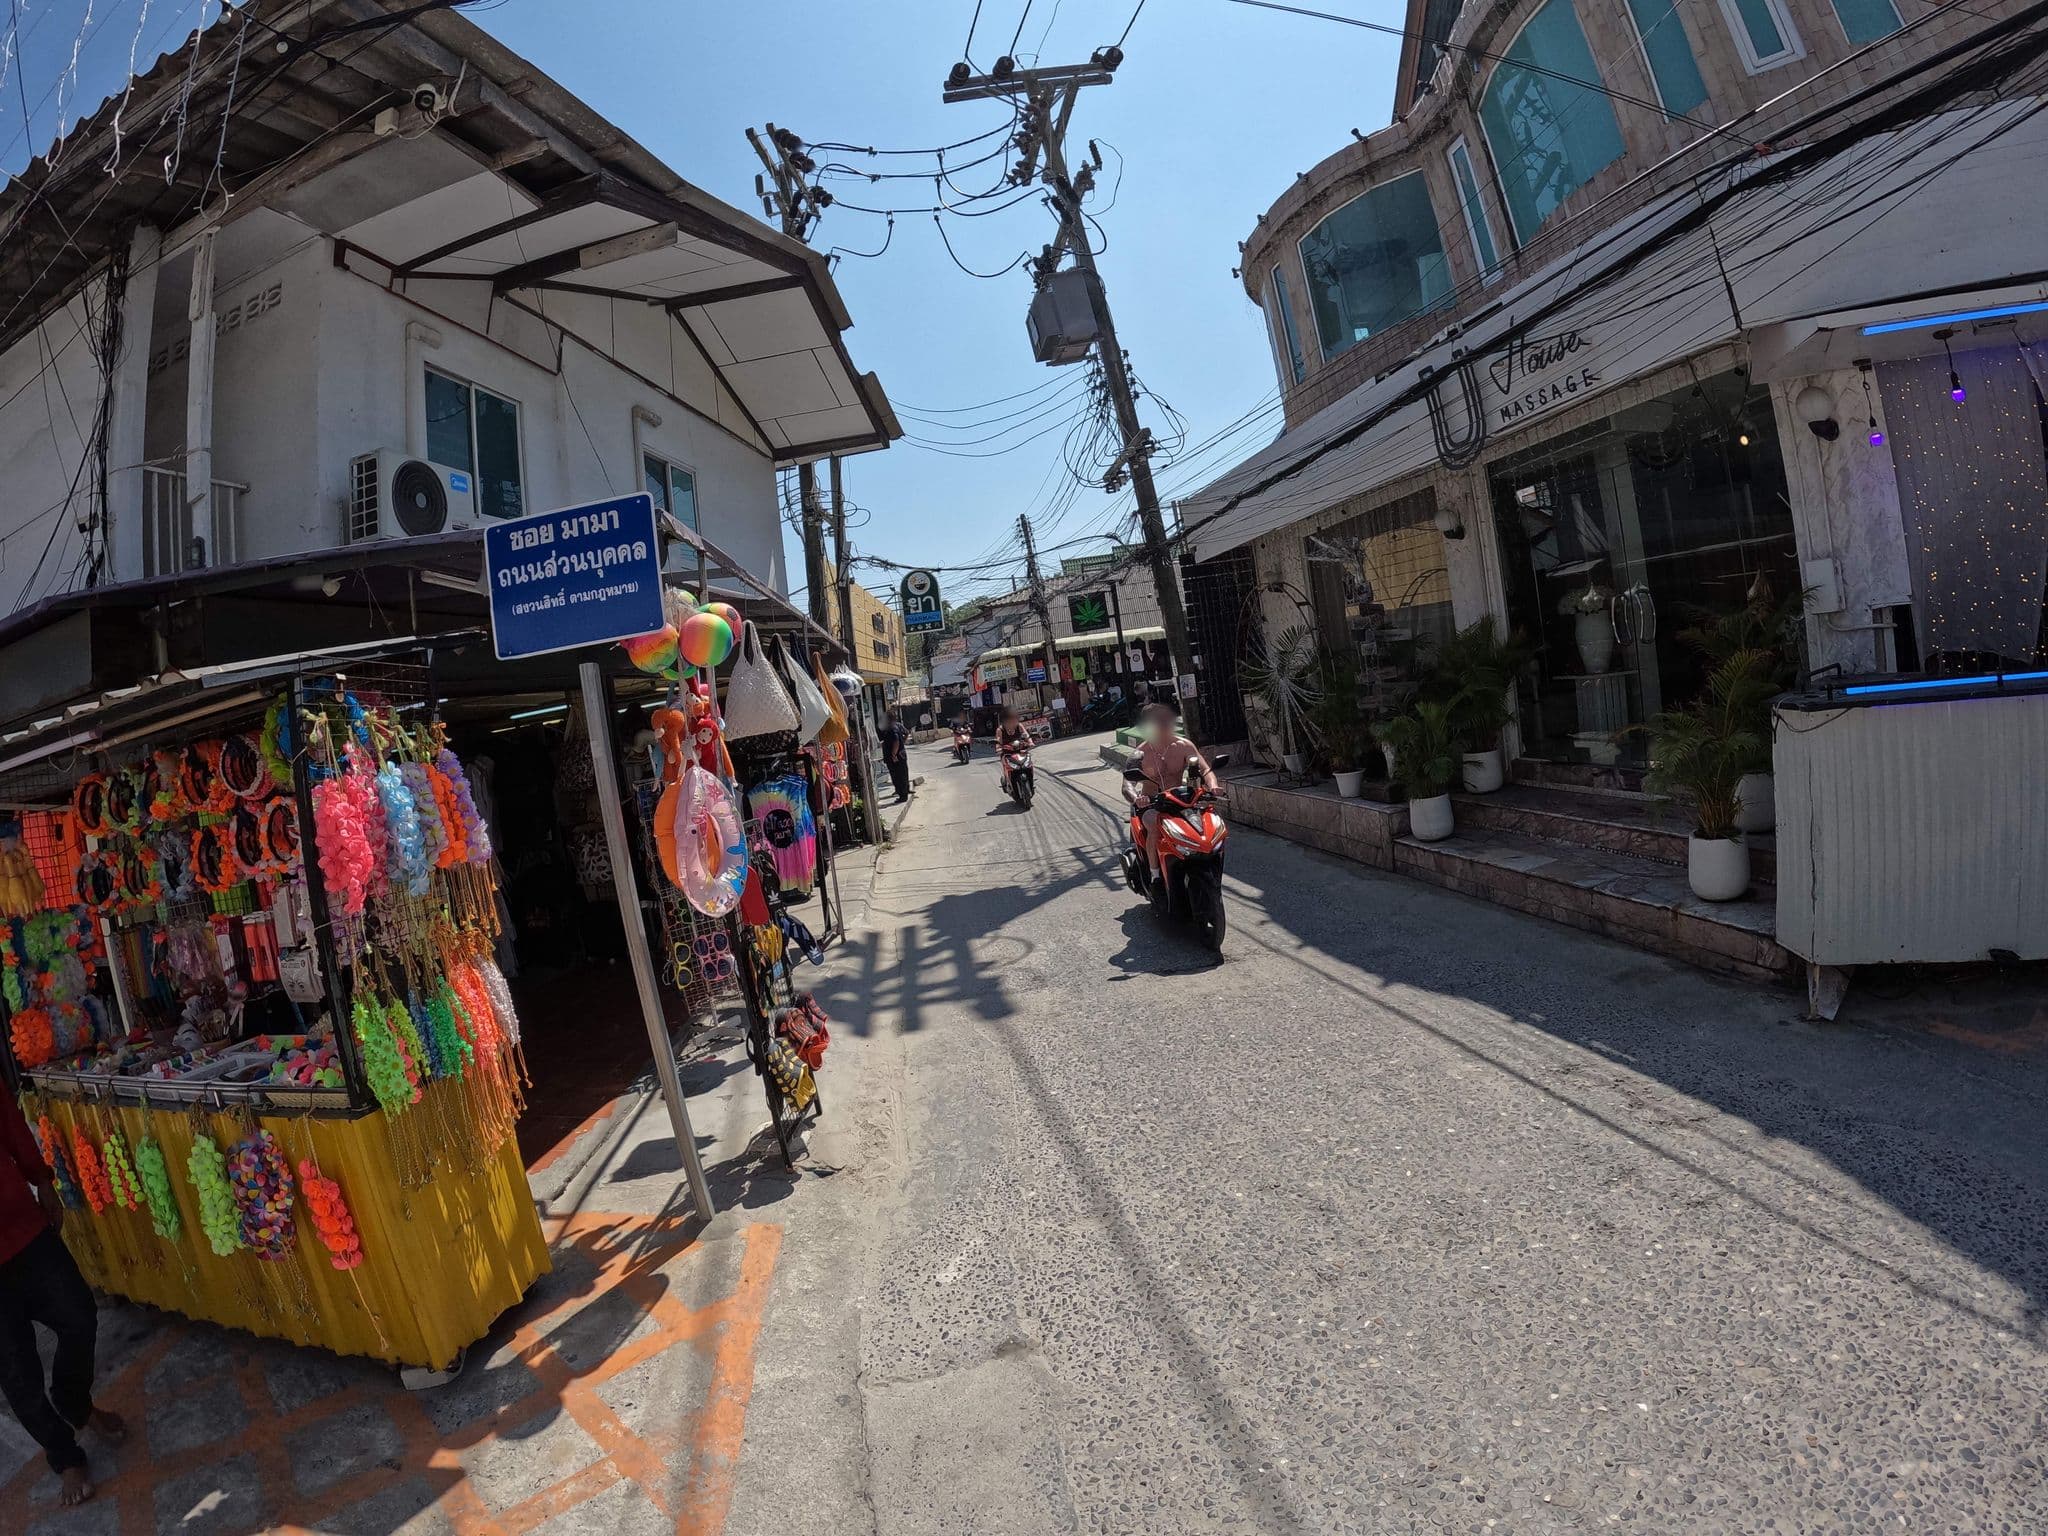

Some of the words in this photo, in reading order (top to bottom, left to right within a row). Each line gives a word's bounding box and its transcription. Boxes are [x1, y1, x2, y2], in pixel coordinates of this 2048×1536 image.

[1500, 368, 1598, 423] MASSAGE
[560, 509, 620, 539] มามา
[497, 540, 647, 588] ถนนส่วนบุคคล
